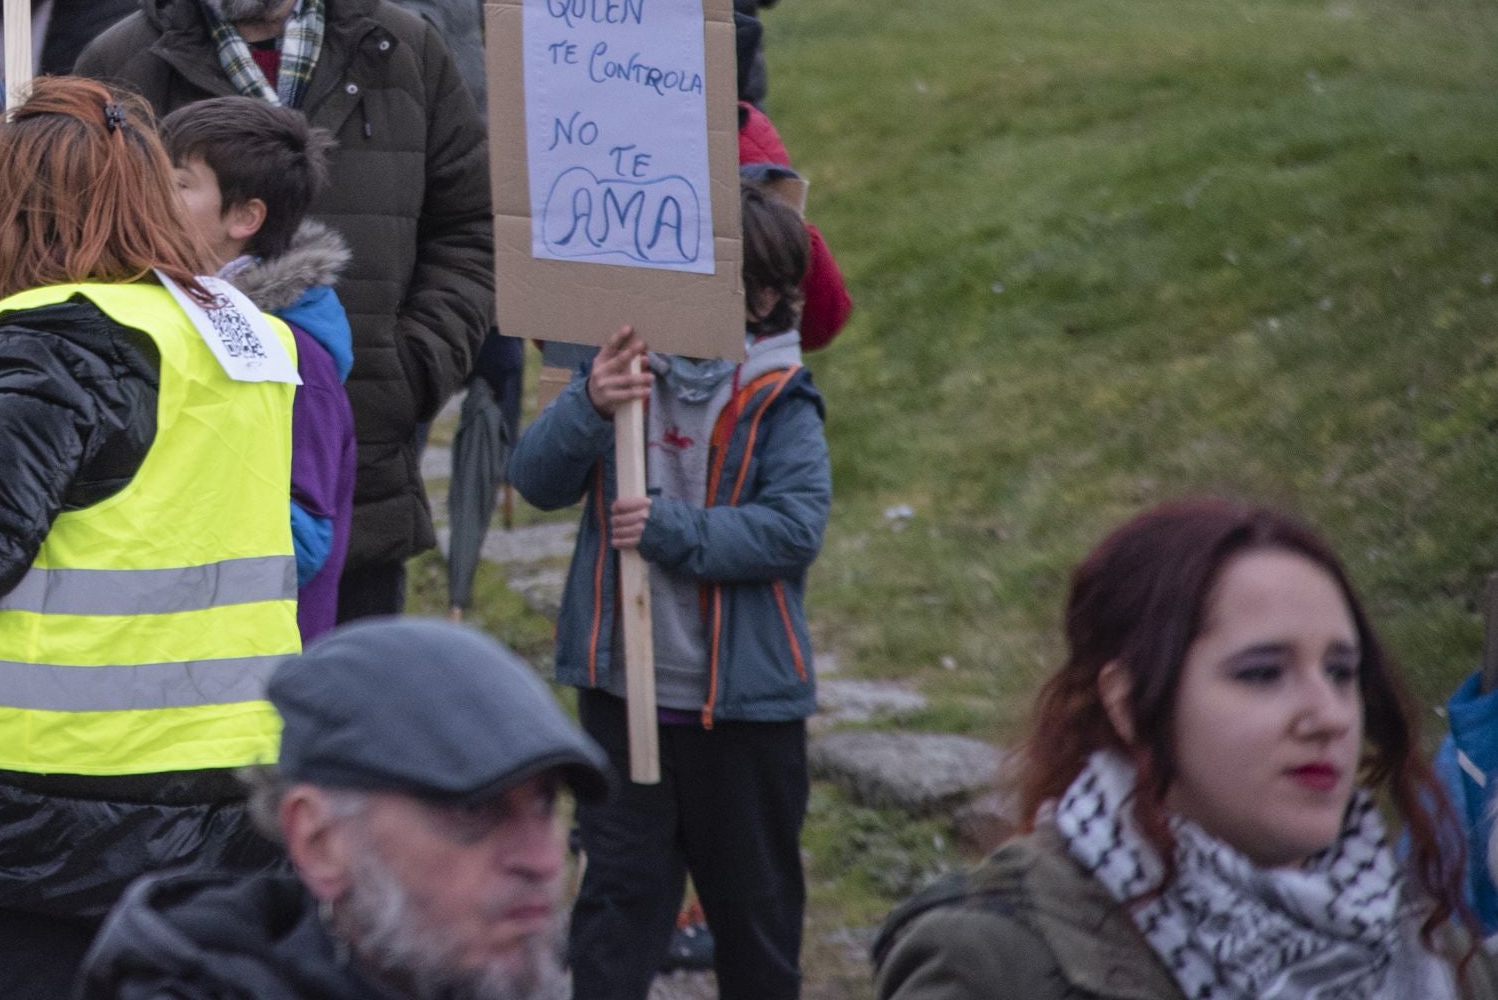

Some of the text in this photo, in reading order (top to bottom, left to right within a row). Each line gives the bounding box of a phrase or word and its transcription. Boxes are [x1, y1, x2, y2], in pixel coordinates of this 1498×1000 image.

[547, 39, 579, 65] TE
[548, 110, 653, 178] NO TE
[553, 187, 690, 262] AMA
